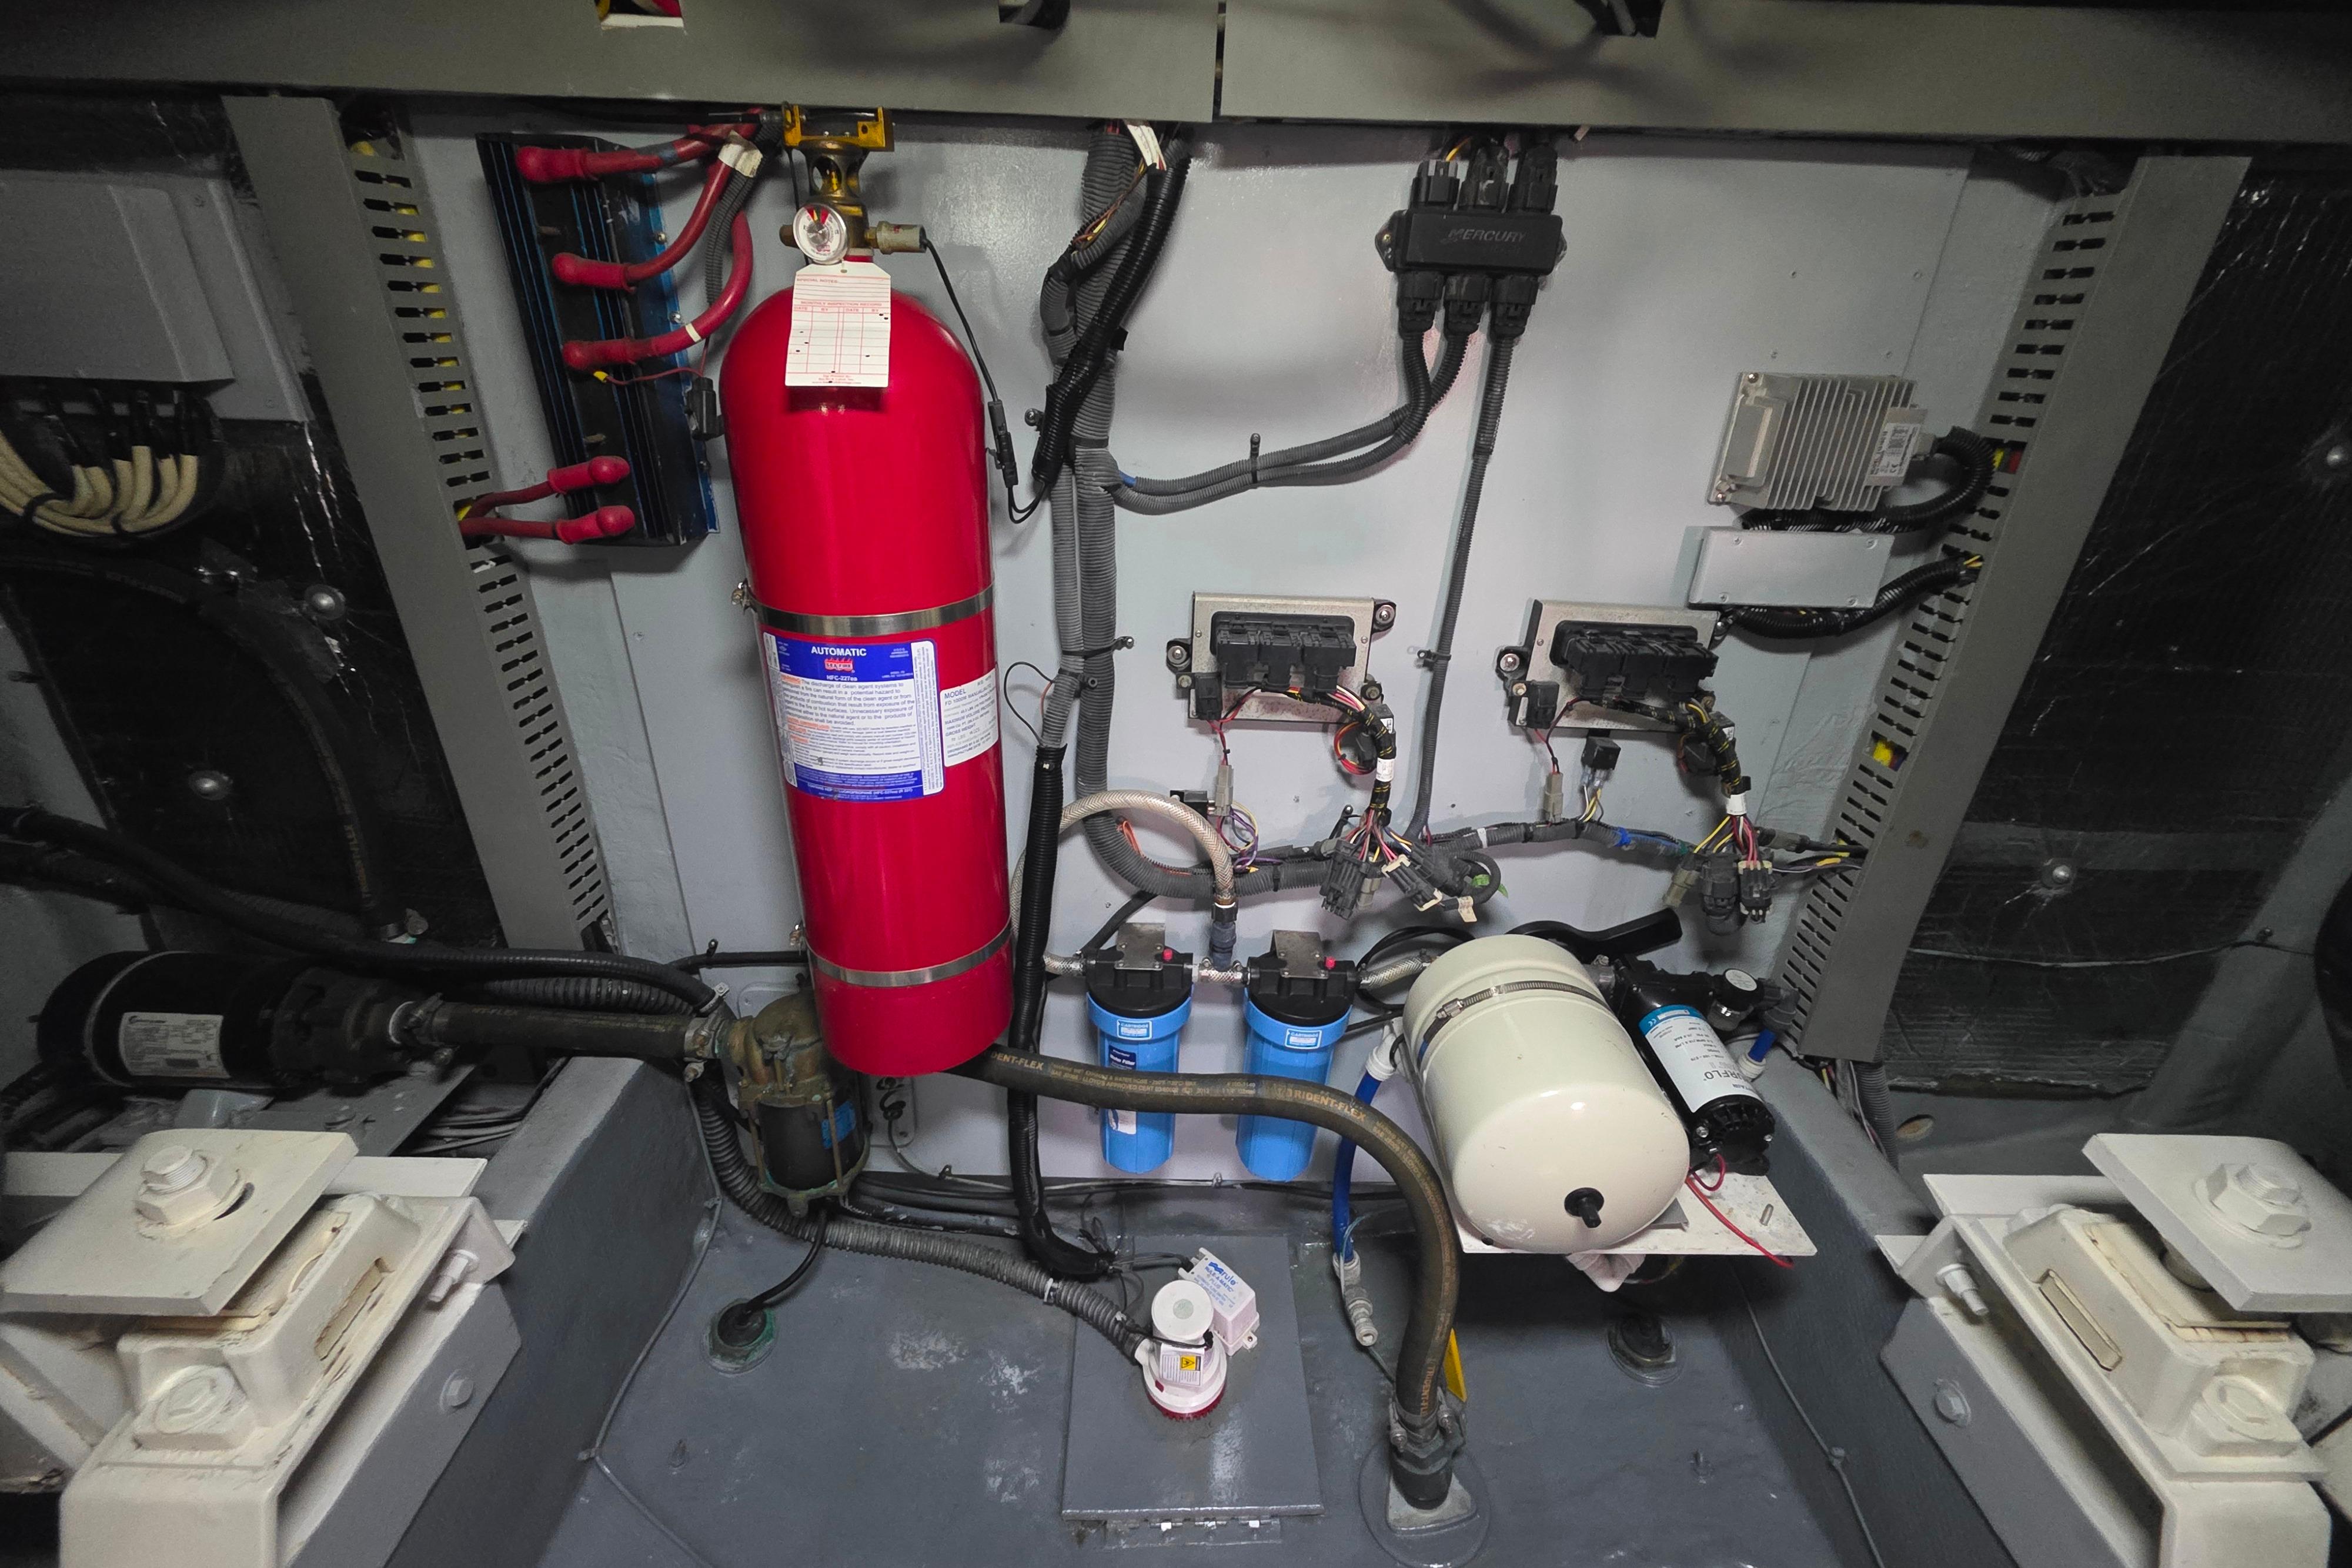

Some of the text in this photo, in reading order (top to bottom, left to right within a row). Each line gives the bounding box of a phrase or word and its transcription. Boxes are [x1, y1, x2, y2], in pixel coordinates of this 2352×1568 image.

[1447, 228, 1527, 243] MERCURY
[811, 646, 867, 657] AUTOMATIC
[944, 688, 967, 699] MODEL
[946, 728, 961, 737] GROSS
[1221, 1272, 1236, 1286] rule
